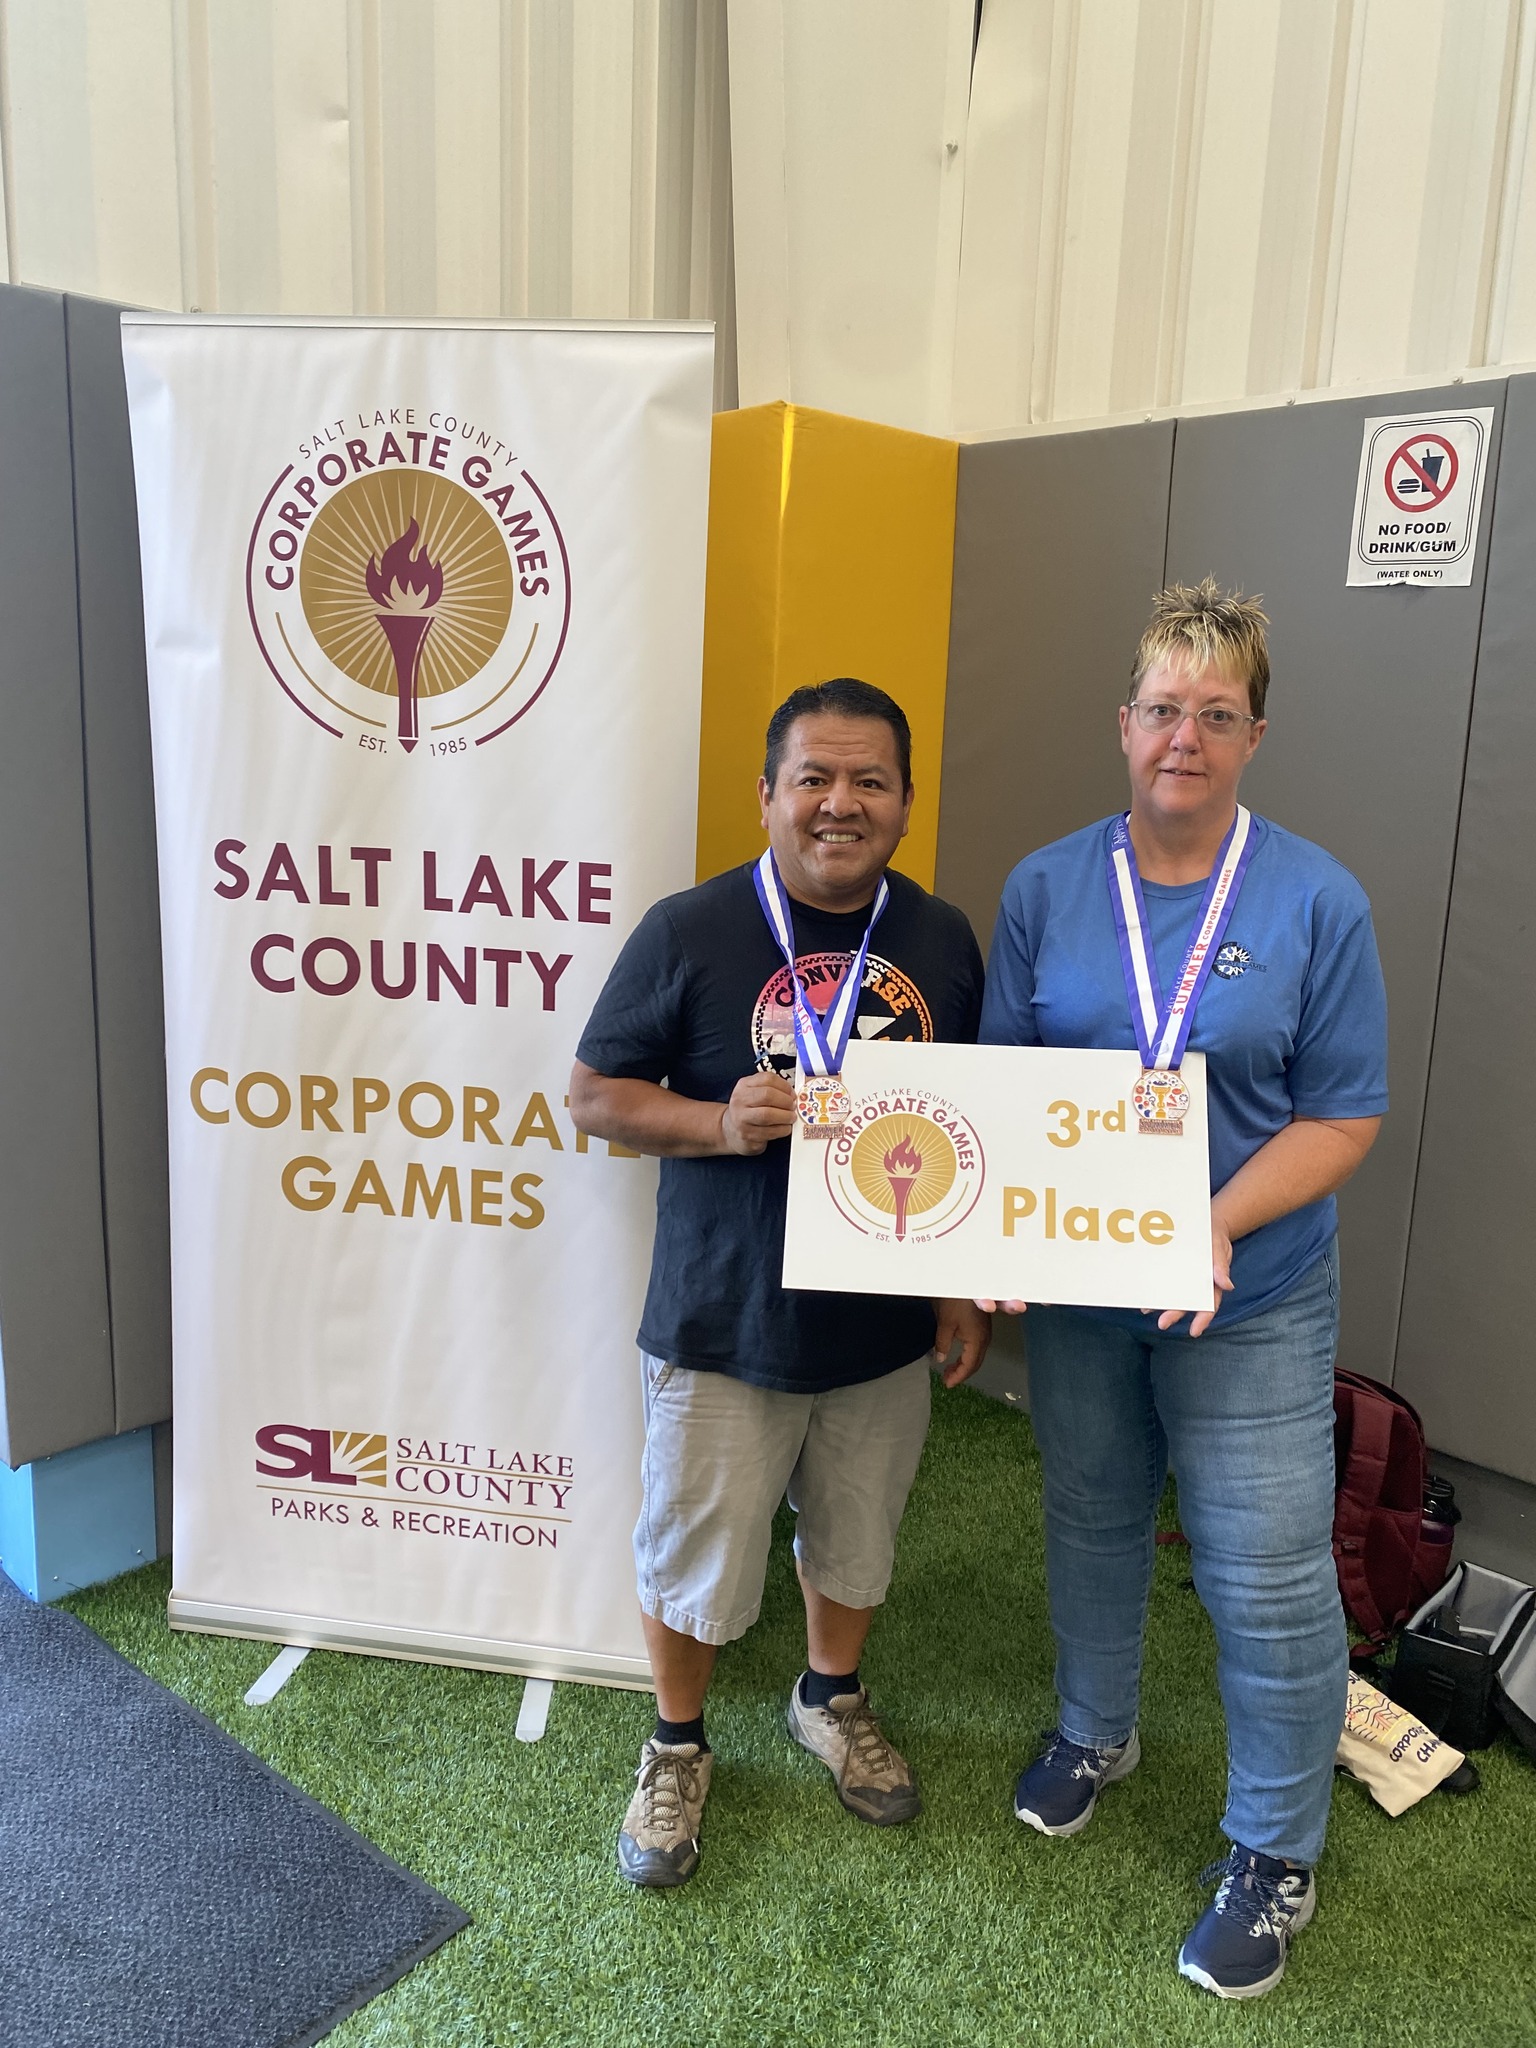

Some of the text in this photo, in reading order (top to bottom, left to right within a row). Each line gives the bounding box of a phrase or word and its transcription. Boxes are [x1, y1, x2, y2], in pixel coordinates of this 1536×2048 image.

[299, 408, 518, 467] SALT LAKE COUNTY
[265, 431, 550, 597] CORPORATE GAMES
[1378, 522, 1451, 536] NO FOOD/
[1369, 540, 1456, 554] DRINK/GUM
[1413, 570, 1443, 579] ONLY)
[358, 734, 468, 757] EST. 1985
[213, 838, 612, 925] SALT LAKE
[1172, 869, 1232, 1015] SUMMER CORPORATE GAMES
[250, 933, 574, 1012] COUNTY
[775, 963, 911, 1016] CONVRSE
[1165, 944, 1195, 1014] SALT LAKE COUNTY
[190, 1066, 641, 1158] CORPORA
[855, 1087, 960, 1115] SALT LAKE COUNTY
[1046, 1099, 1126, 1148] 3rd
[834, 1097, 975, 1171] CORPORATE GAMES
[281, 1155, 546, 1230] GAMES
[1003, 1186, 1175, 1246] Place
[875, 1232, 932, 1244] EST. 1985
[396, 1437, 574, 1478] SALT LAKE
[395, 1466, 573, 1510] COUNTY
[271, 1497, 558, 1549] PARKS & RECREATION
